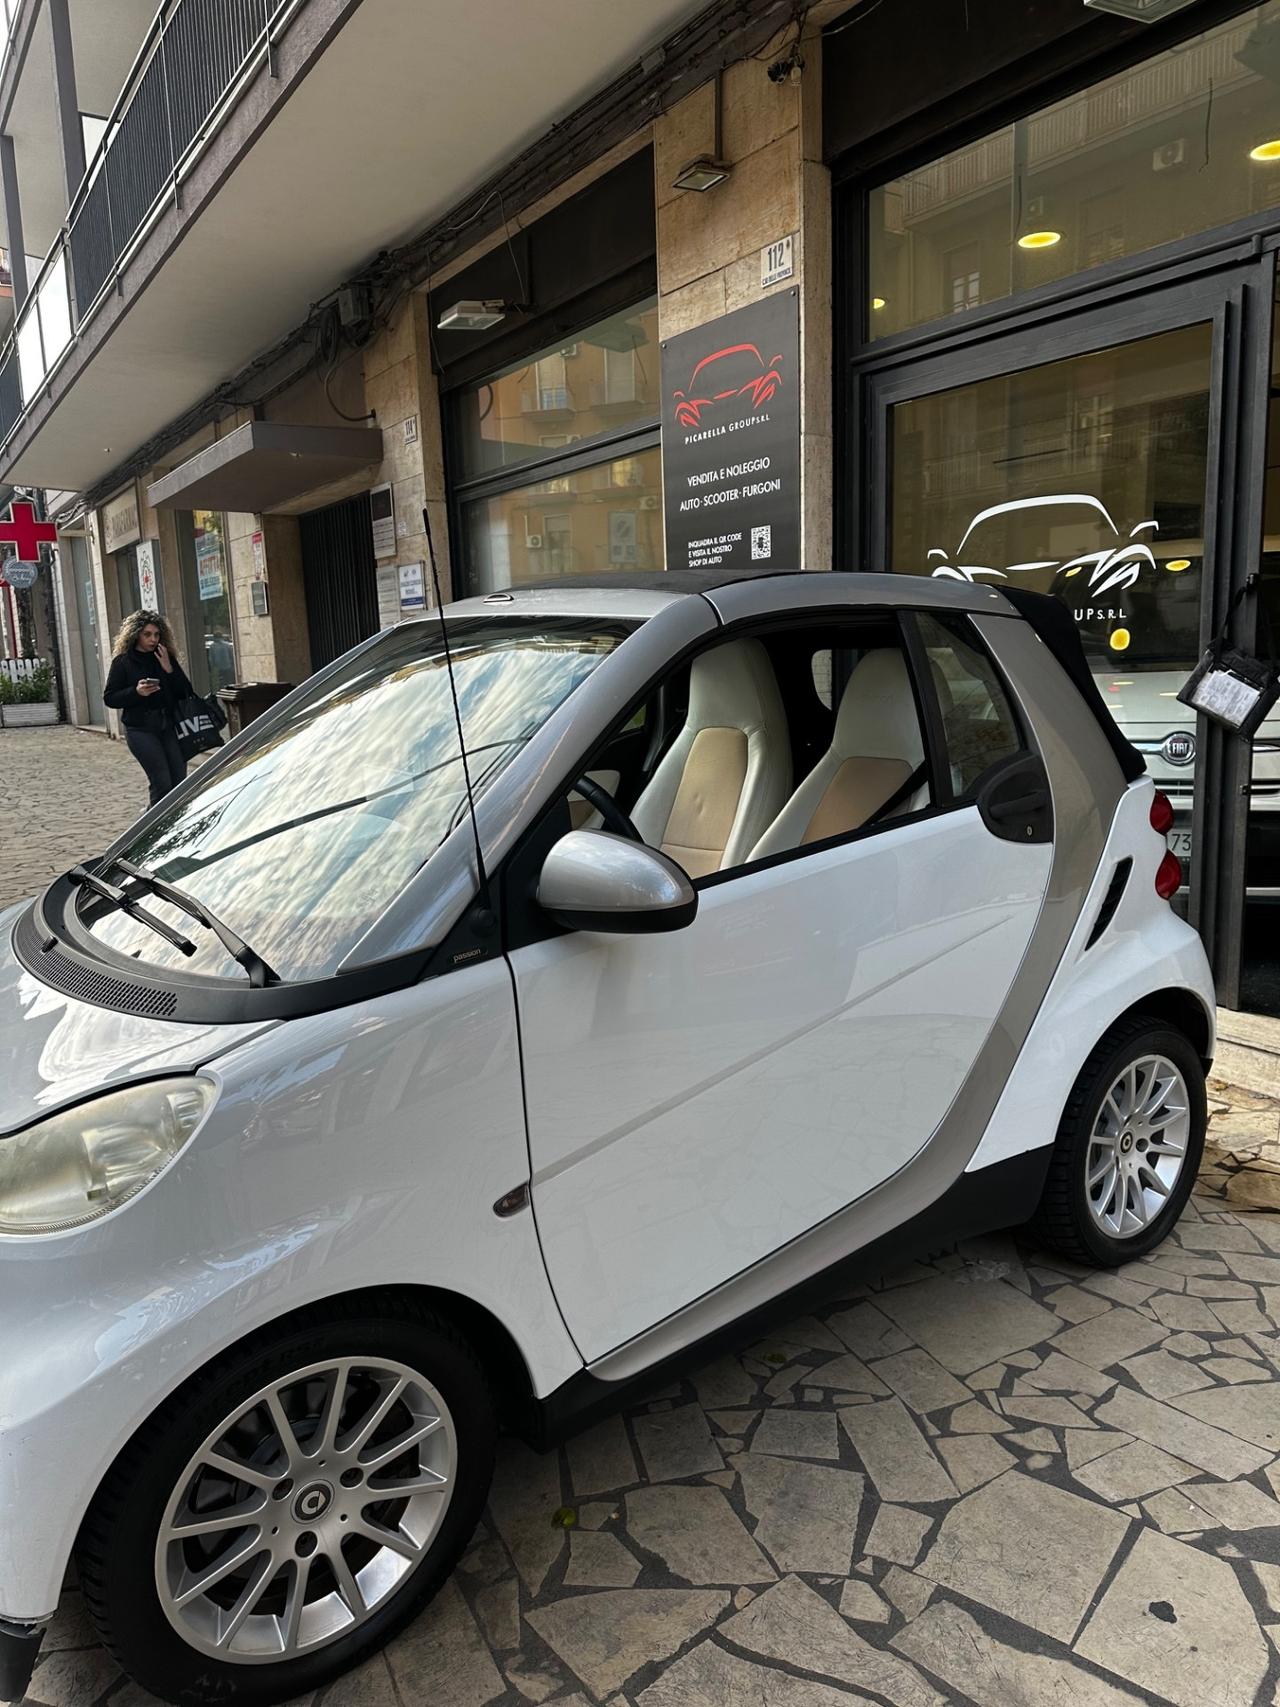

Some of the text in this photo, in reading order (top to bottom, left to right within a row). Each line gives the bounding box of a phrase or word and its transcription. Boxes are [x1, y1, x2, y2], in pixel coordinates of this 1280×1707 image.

[684, 425, 726, 445] PICARELLA
[687, 457, 770, 487] VENDITA E NOLEGGIO
[688, 532, 742, 549] INQUADRA IL QR CODE
[688, 550, 692, 558] E
[692, 548, 706, 557] VISITA
[712, 544, 732, 554] NOSTRO
[688, 559, 701, 568] SHOP
[708, 555, 722, 565] AUTO
[174, 714, 214, 740] LIVE
[1172, 743, 1189, 755] FIAT
[453, 948, 482, 963] passion
